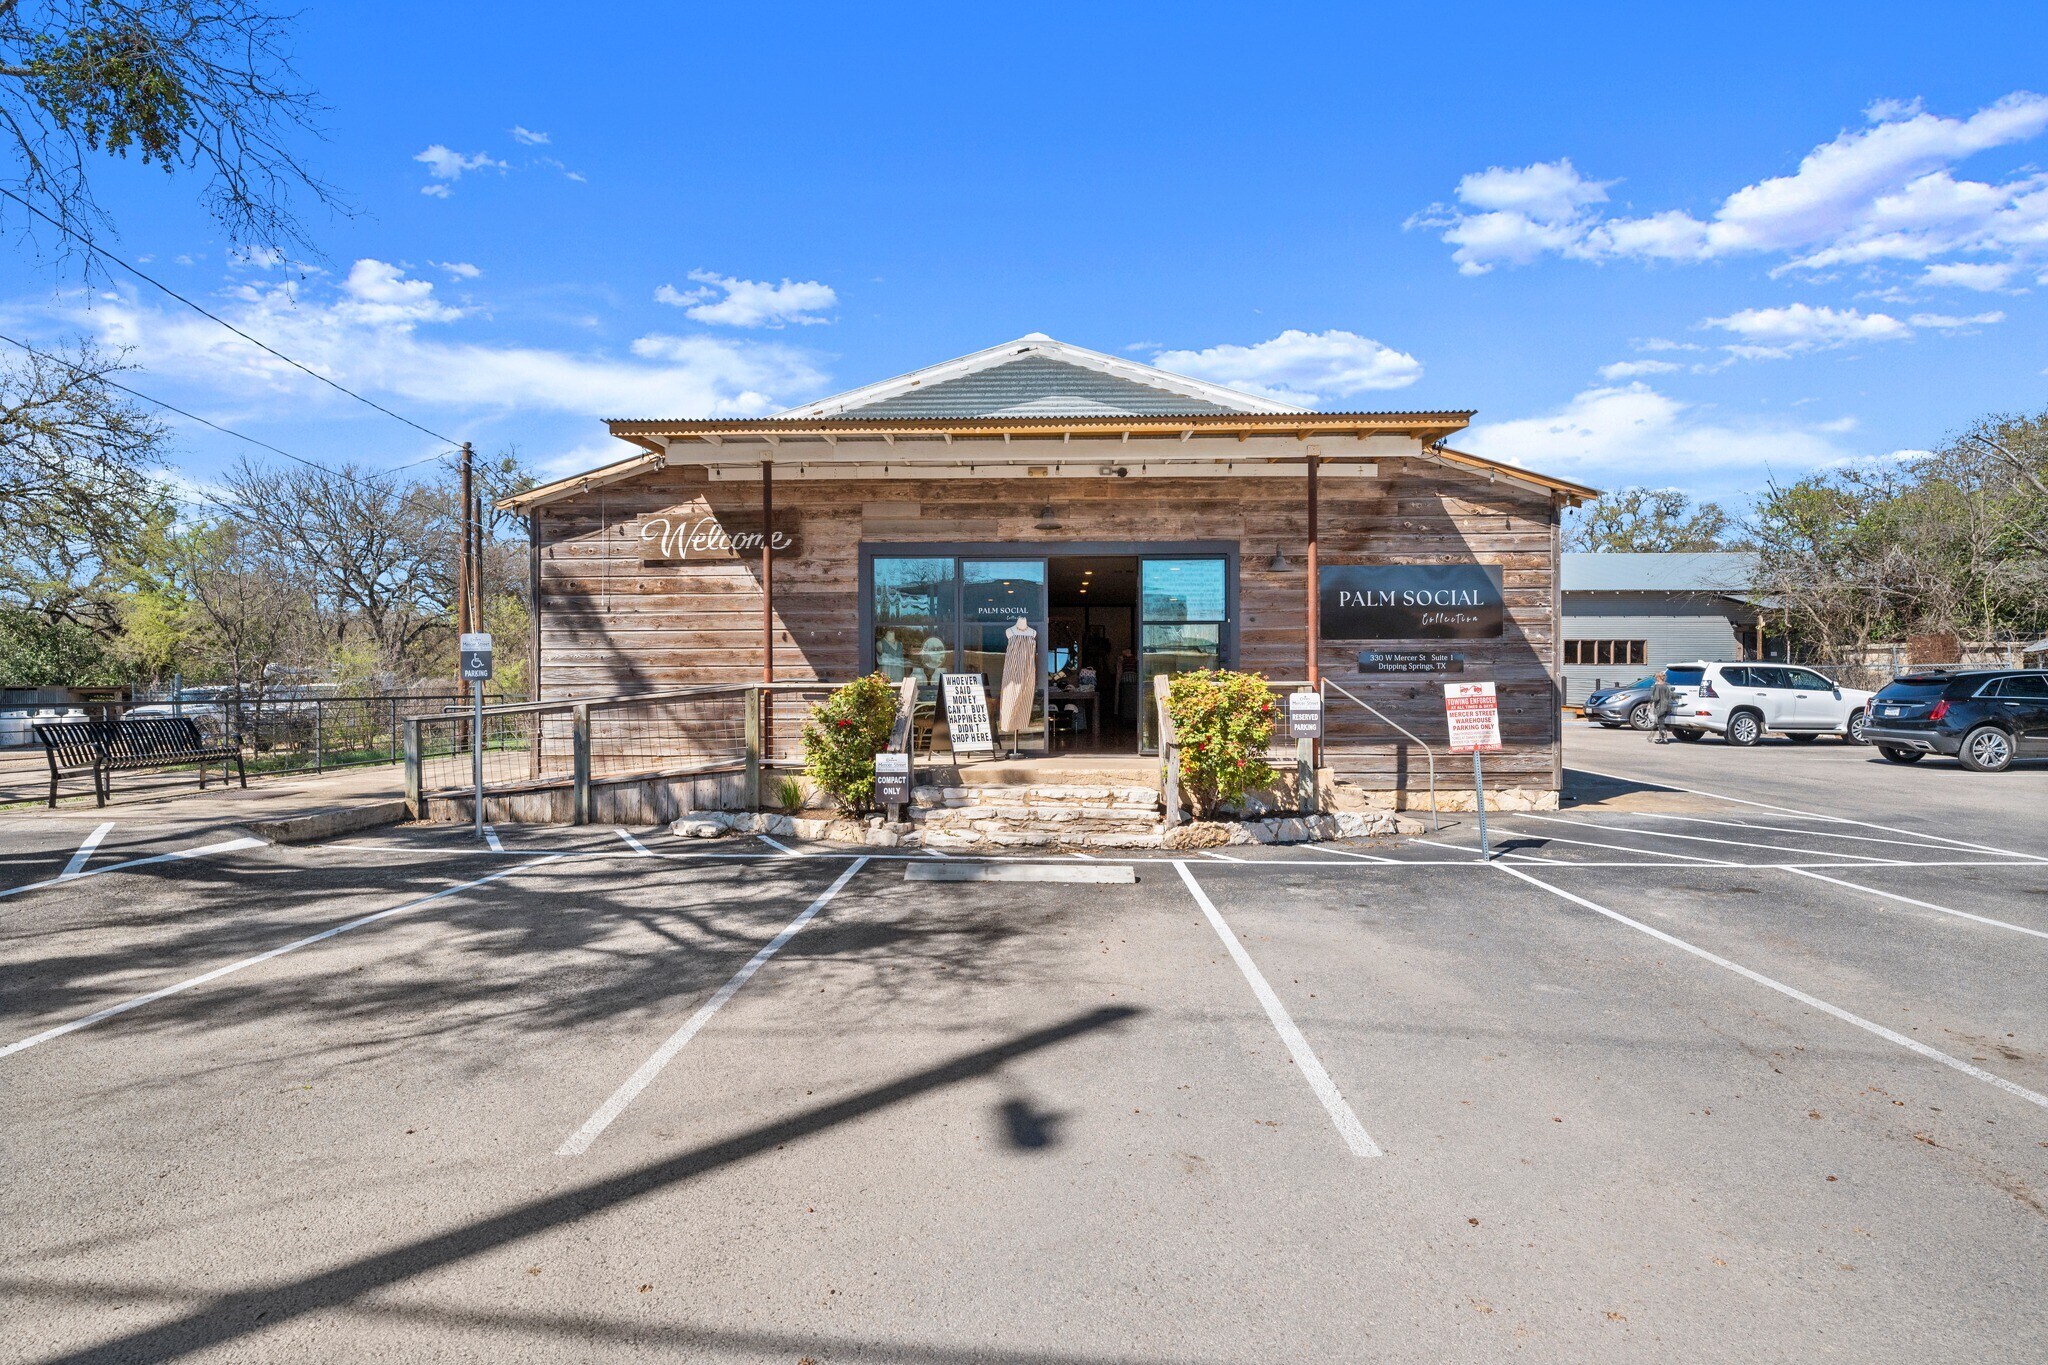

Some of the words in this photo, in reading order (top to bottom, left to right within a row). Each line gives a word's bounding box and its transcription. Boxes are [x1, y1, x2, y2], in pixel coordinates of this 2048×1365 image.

[640, 516, 793, 559] Welcome
[1339, 590, 1396, 607] PALM
[1402, 589, 1485, 606] SOCIAL
[1421, 612, 1479, 626] Collection
[1378, 662, 1407, 671] Dripping
[946, 676, 978, 685] WHOEVER
[955, 686, 971, 695] SAID
[952, 695, 976, 705] MONEY
[1470, 696, 1496, 704] ENFORCED
[971, 704, 985, 713] BUY
[949, 714, 987, 723] HAPPINESS
[952, 734, 969, 743] SHOP
[971, 733, 992, 742] HERE.
